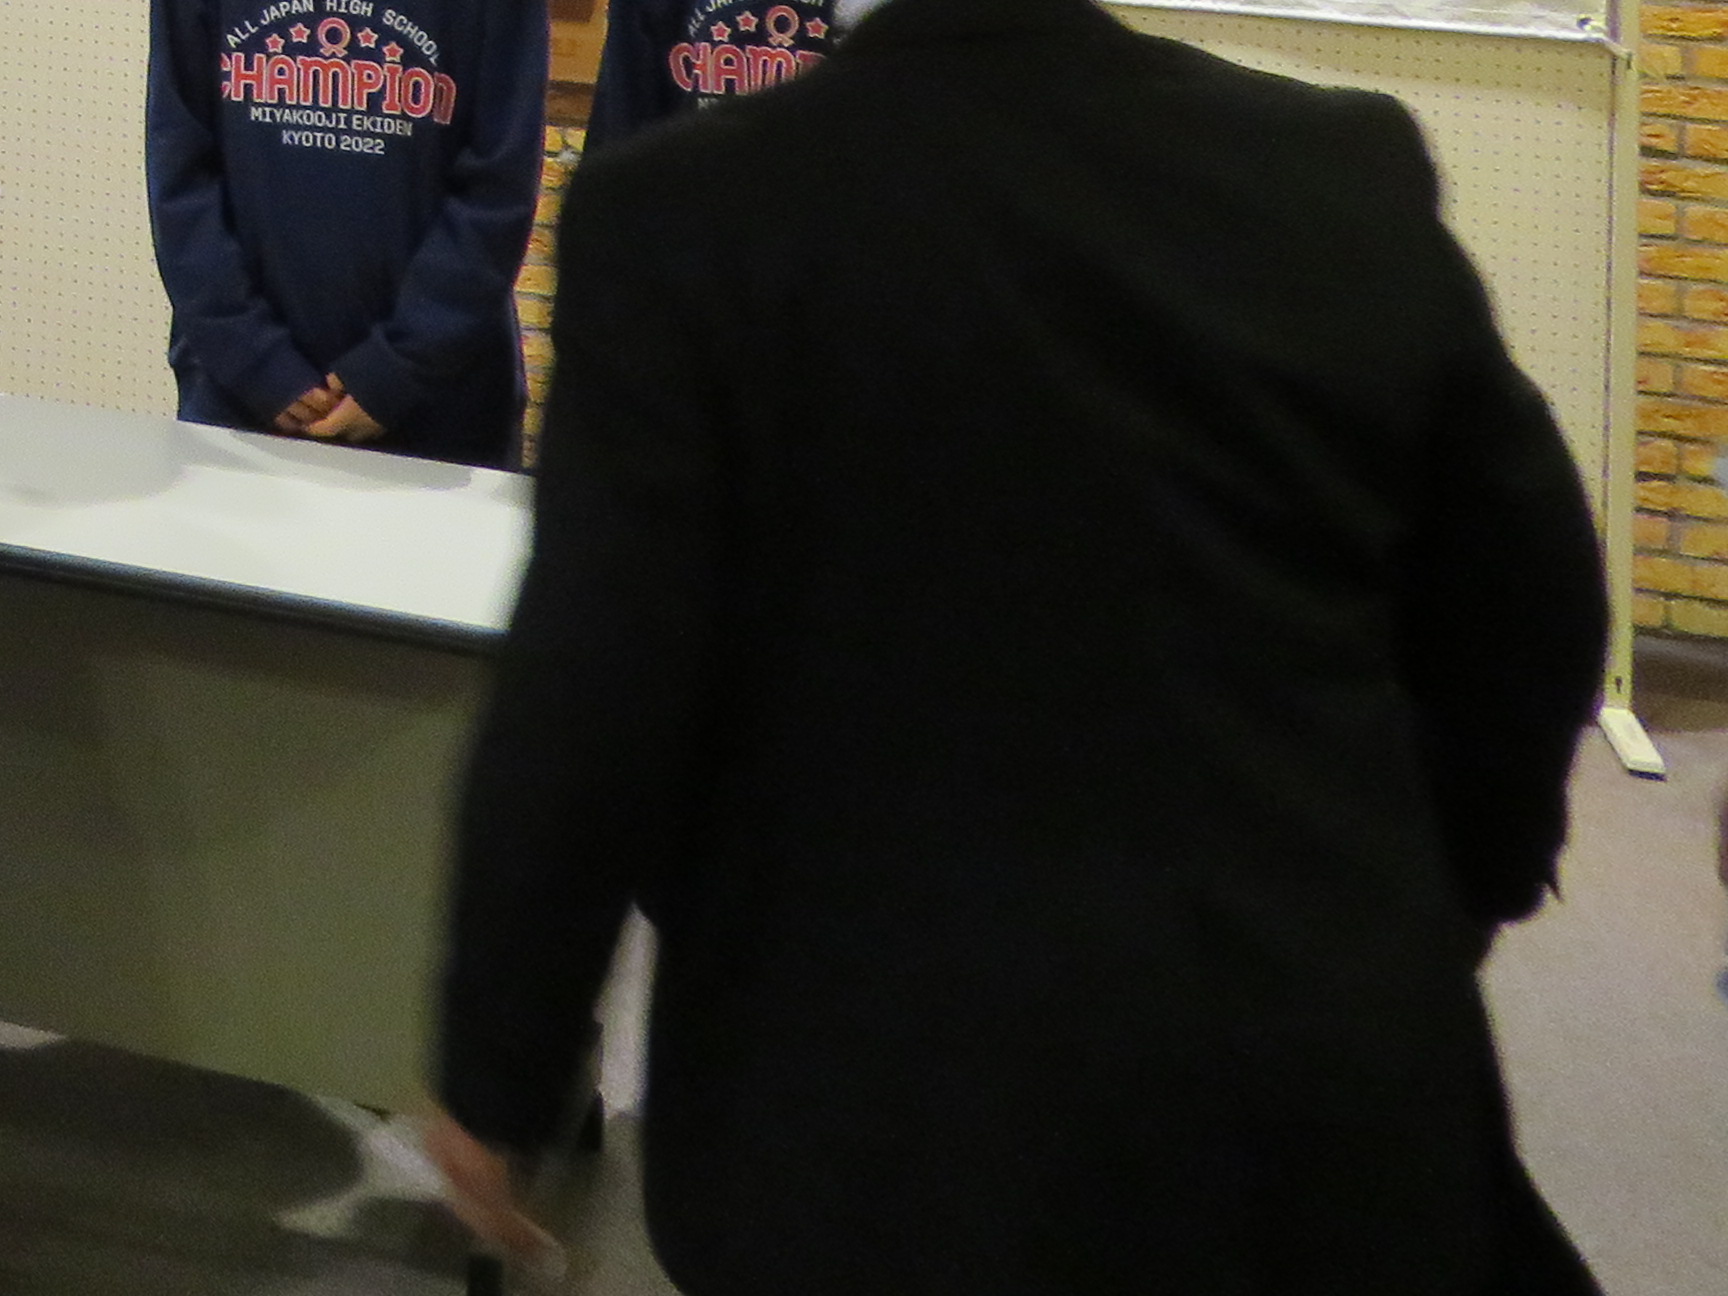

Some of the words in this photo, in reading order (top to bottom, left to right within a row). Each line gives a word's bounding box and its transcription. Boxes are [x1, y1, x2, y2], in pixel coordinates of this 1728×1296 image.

[226, 19, 259, 49] ALL
[382, 8, 441, 67] SCHOOL
[250, 106, 347, 129] MIYAKOOJI
[352, 113, 413, 137] EKIDEN
[282, 129, 337, 150] KYOTO
[340, 134, 386, 155] 2022
